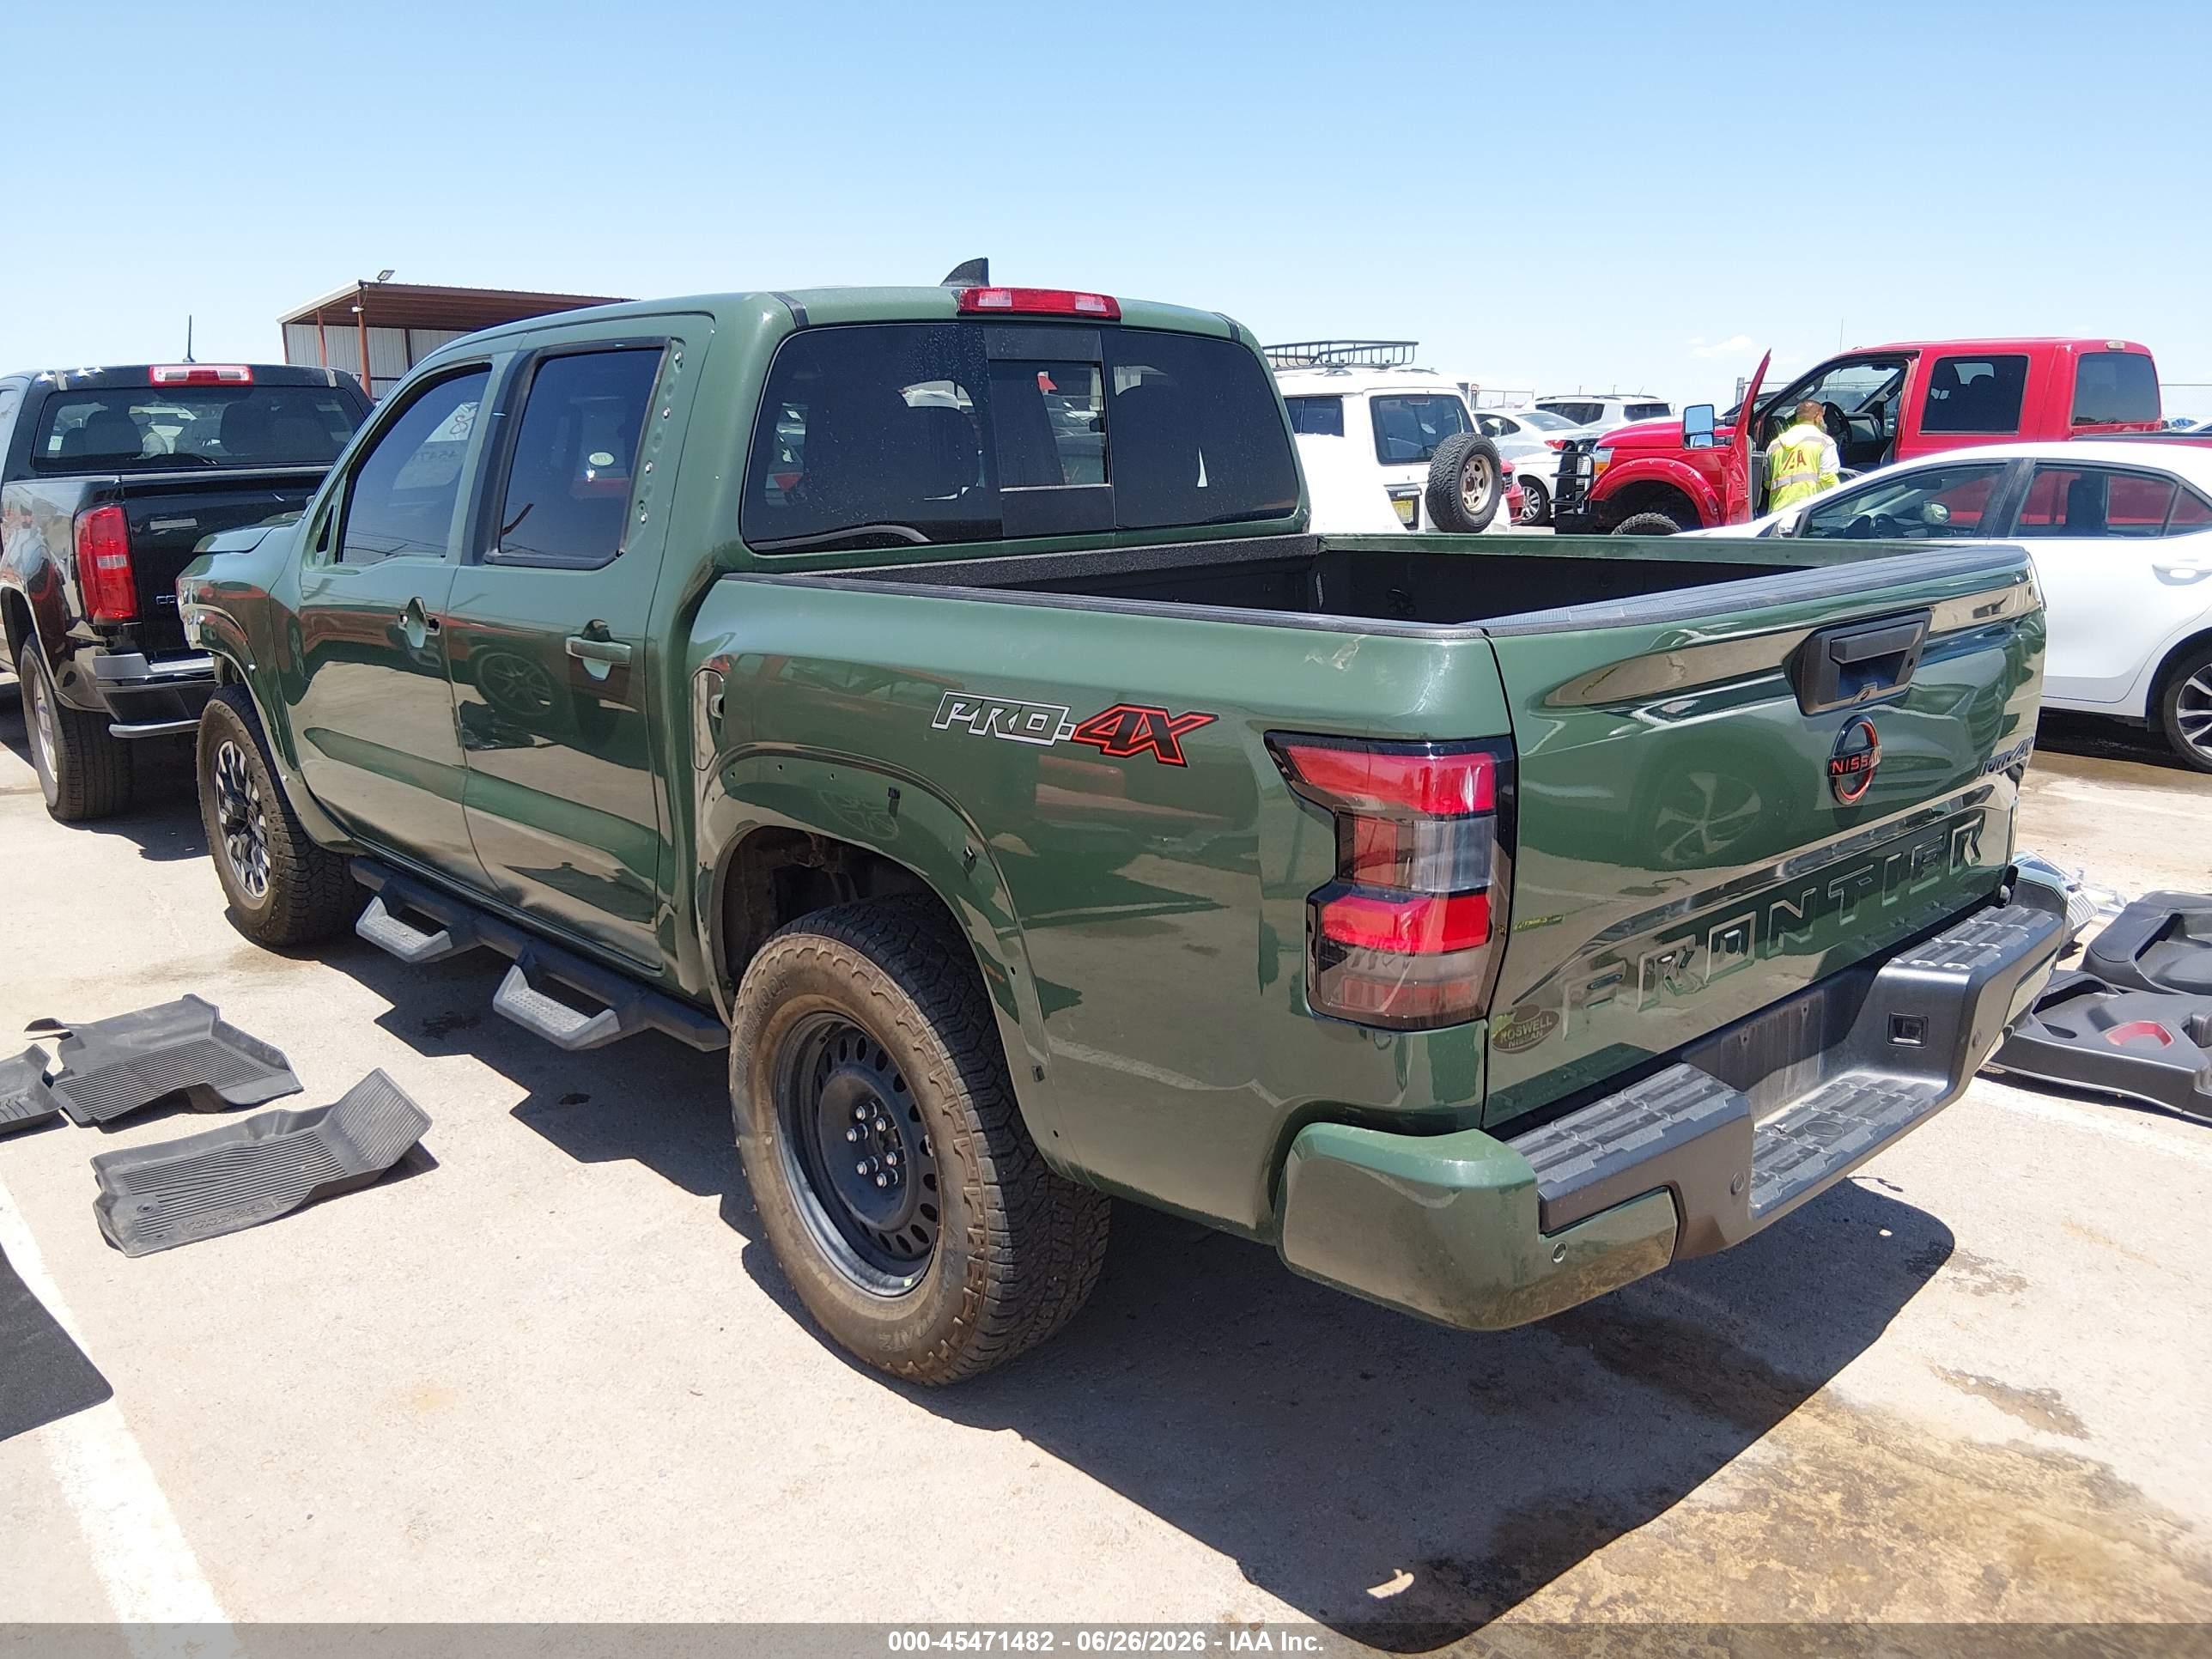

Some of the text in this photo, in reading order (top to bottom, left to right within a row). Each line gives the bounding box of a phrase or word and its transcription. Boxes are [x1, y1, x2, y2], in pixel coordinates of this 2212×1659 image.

[1831, 748, 1881, 775] NISSAN
[1562, 809, 1985, 1042] FRONTIER
[1499, 1016, 1553, 1044] ROSWELL
